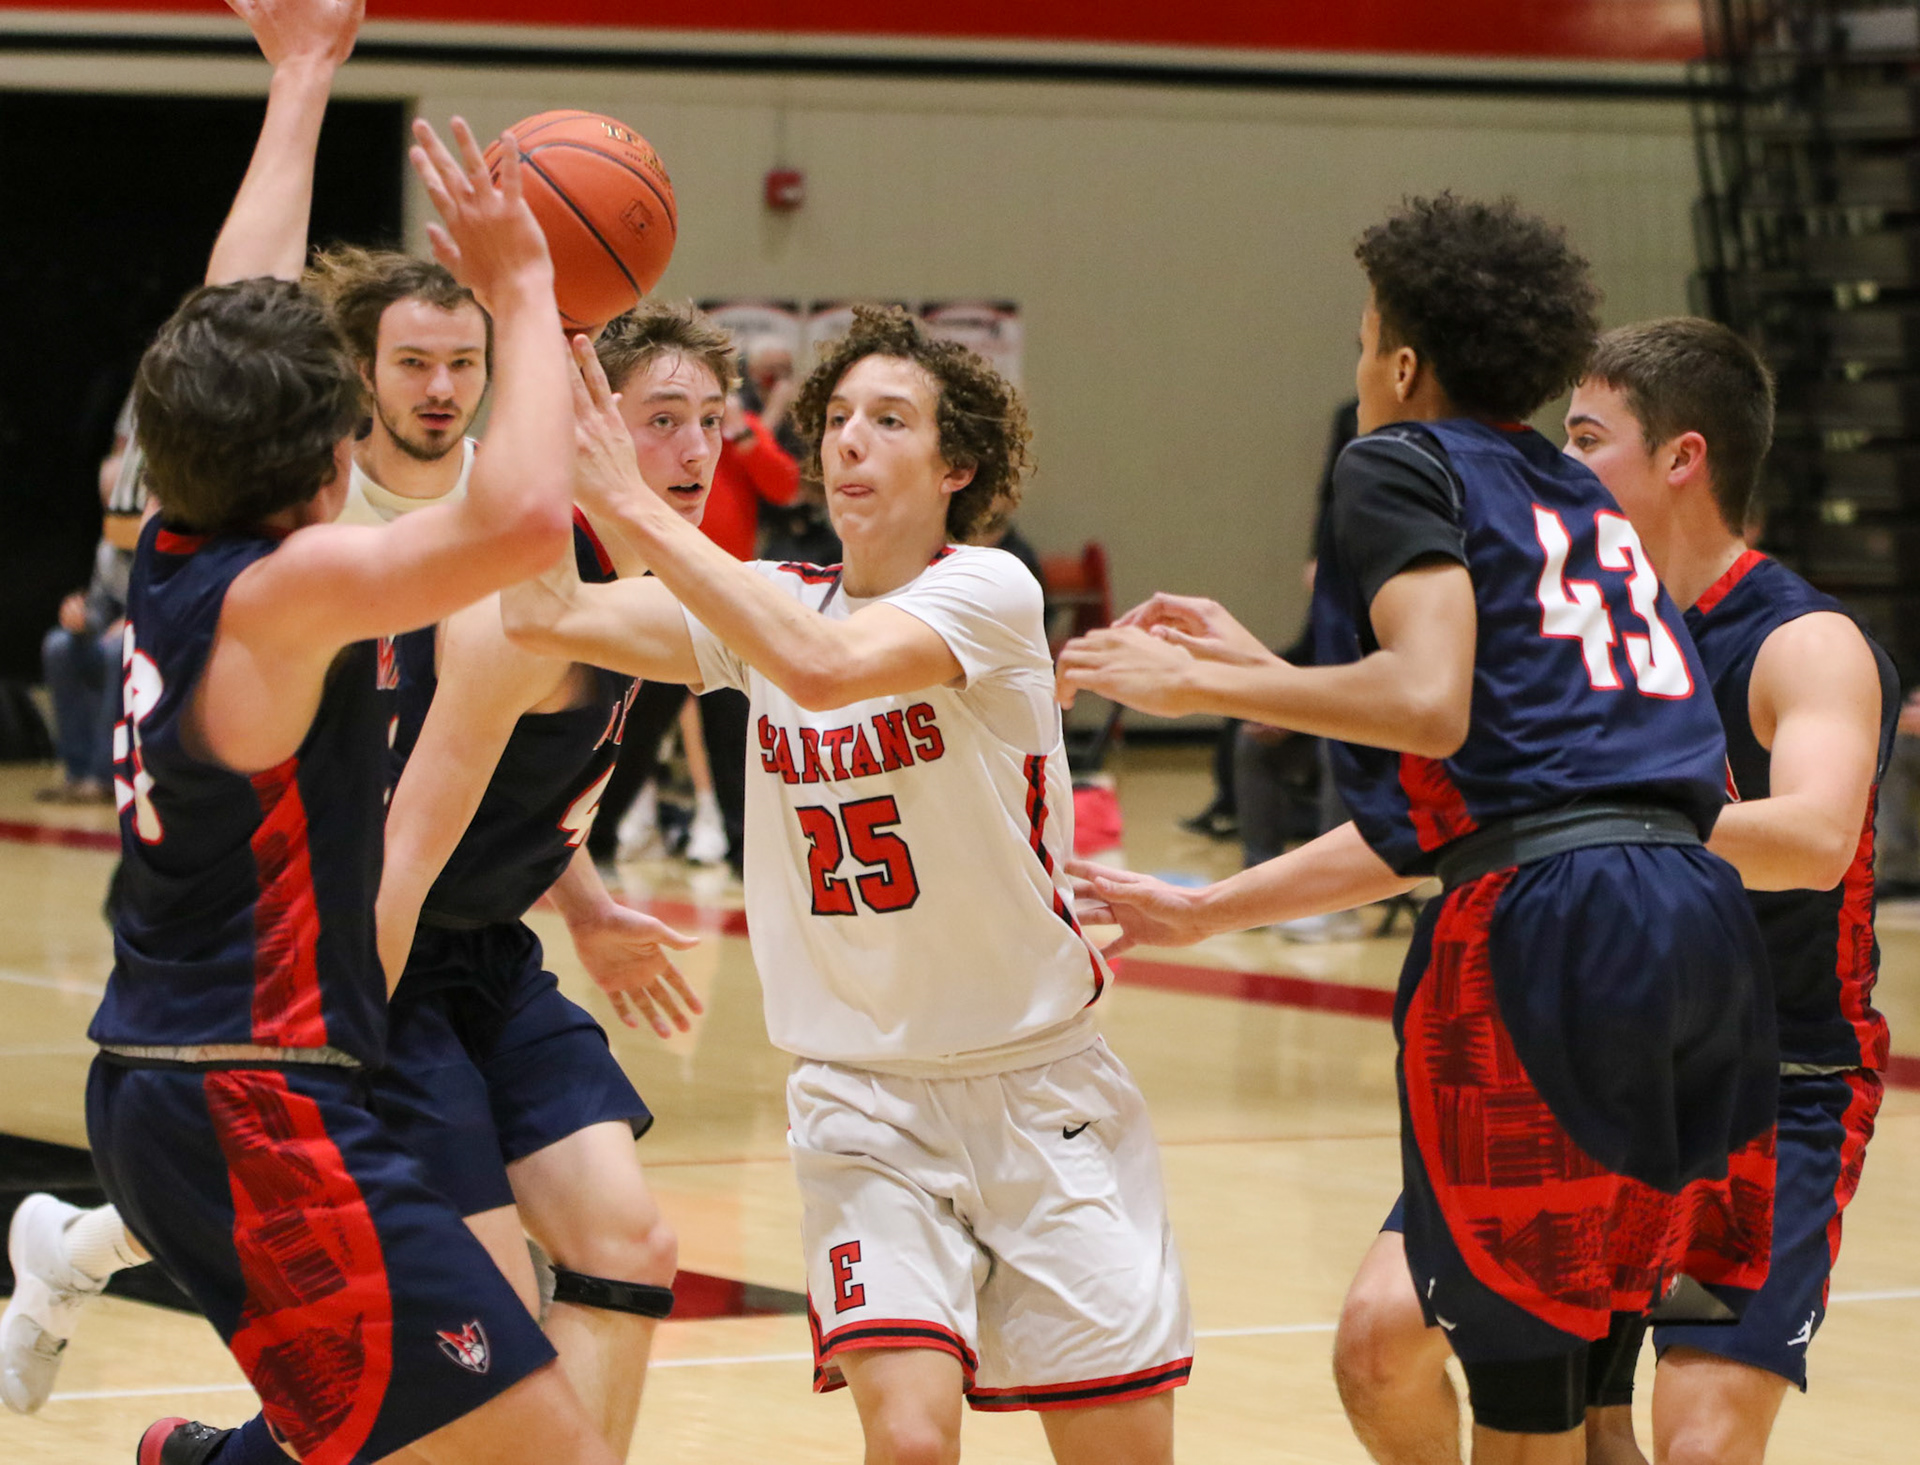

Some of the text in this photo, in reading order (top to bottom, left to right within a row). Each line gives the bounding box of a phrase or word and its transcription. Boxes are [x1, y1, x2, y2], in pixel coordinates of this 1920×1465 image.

[1531, 501, 1695, 700] 43
[757, 702, 945, 784] SPARTANS
[794, 794, 920, 916] 25
[829, 1240, 866, 1315] E
